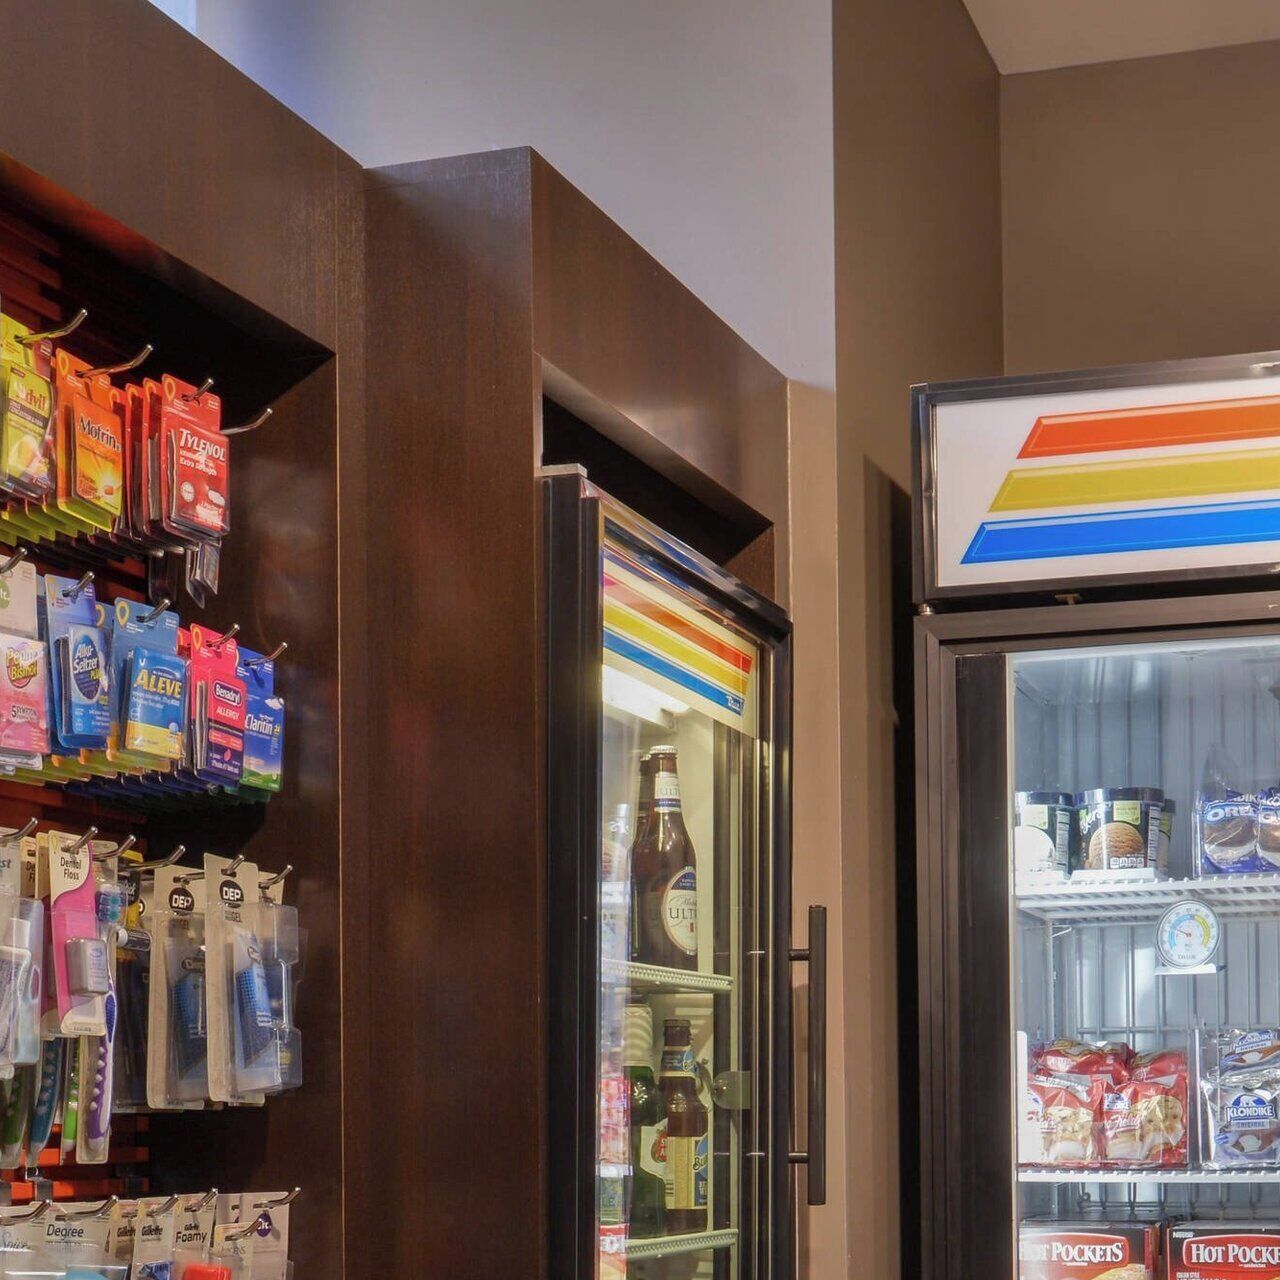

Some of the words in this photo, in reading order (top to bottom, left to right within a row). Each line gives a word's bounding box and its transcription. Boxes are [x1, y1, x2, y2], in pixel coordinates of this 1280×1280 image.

[79, 414, 117, 449] Motrin
[180, 429, 225, 461] TYLENOL
[73, 656, 98, 675] Seltzer
[134, 669, 182, 698] ALEVE
[215, 684, 241, 705] Benadryl
[216, 706, 239, 720] ALLERGY
[245, 713, 273, 736] Claritin
[63, 868, 79, 880] Floss
[172, 894, 192, 908] DEP
[223, 887, 241, 900] DEP
[1226, 1105, 1275, 1118] KLONDIKE
[46, 1224, 84, 1240] Degree
[141, 1225, 163, 1236] Gillette
[175, 1231, 208, 1244] Foamy
[1052, 1242, 1123, 1262] POCKETS
[1191, 1244, 1225, 1263] HOT
